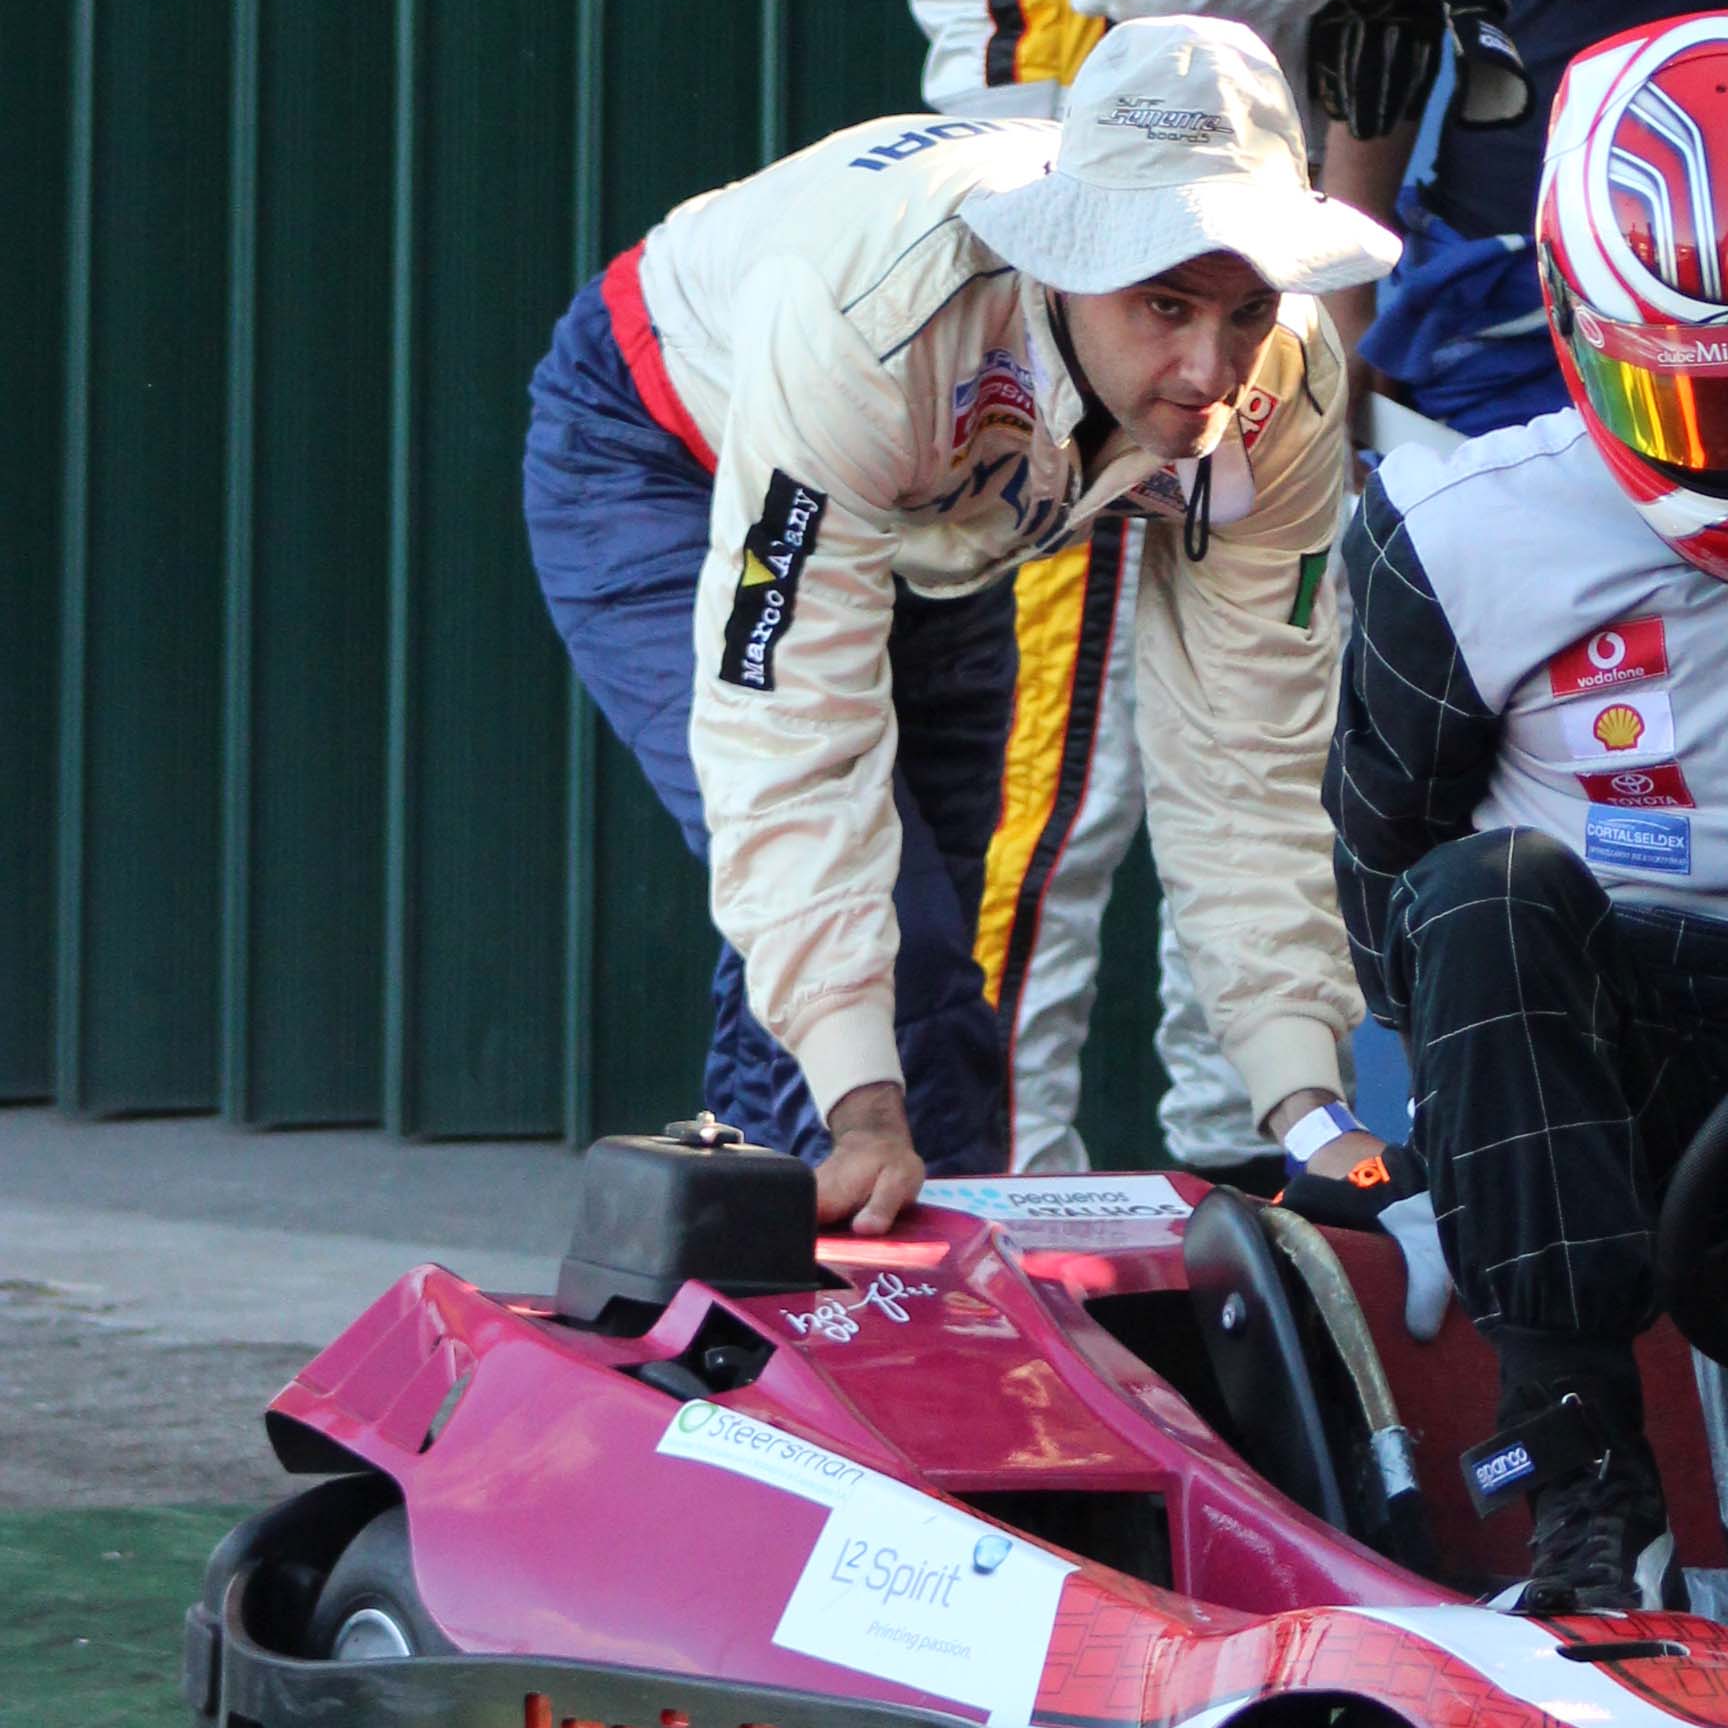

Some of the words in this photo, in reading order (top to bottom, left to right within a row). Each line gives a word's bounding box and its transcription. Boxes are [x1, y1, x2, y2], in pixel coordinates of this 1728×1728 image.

[1657, 350, 1695, 364] clube
[741, 589, 785, 685] Marco
[1577, 666, 1645, 688] vodafone
[1587, 823, 1686, 849] CORTALSELDEX
[1008, 1190, 1129, 1207] pequenos
[708, 1414, 865, 1485] Steersman
[1476, 1447, 1528, 1486] sparco
[865, 1547, 961, 1608] Spirit
